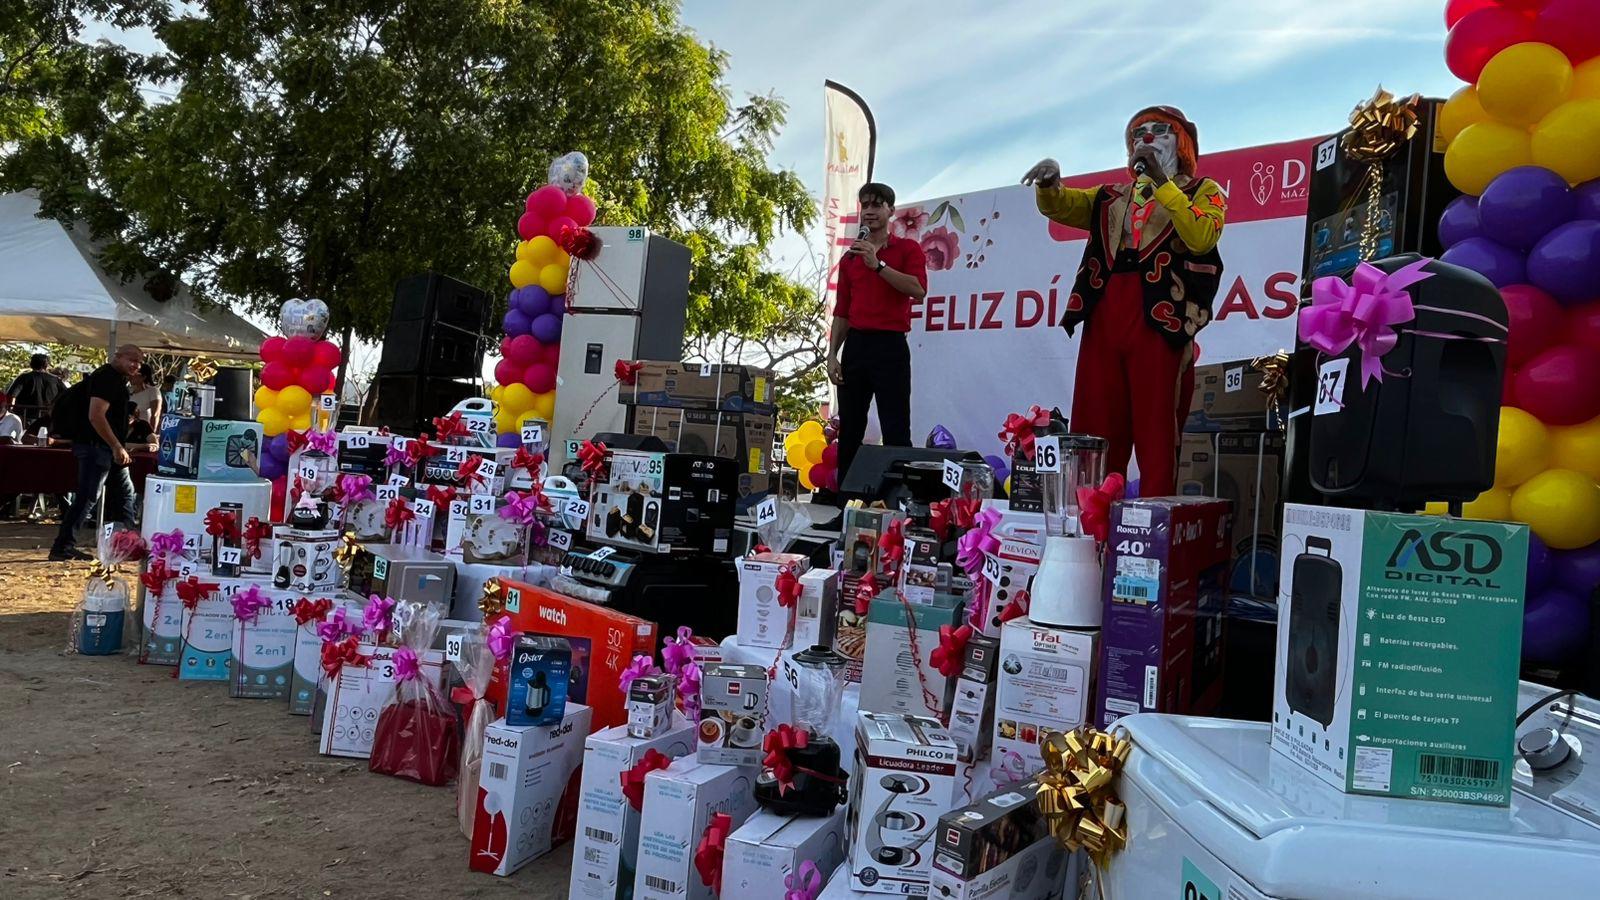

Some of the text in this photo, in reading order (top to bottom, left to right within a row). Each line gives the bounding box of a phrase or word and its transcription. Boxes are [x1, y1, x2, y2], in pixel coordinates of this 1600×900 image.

[1320, 143, 1334, 164] 37
[1280, 187, 1309, 199] MAZ
[628, 229, 642, 239] 98
[909, 291, 1005, 332] FELIZ
[1014, 274, 1062, 329] DÍ
[703, 364, 709, 373] 1
[1226, 372, 1240, 388] 36
[1317, 369, 1341, 404] 67
[324, 397, 333, 407] 9
[205, 421, 230, 433] Oster
[468, 420, 486, 432] 22
[523, 429, 539, 440] 27
[350, 436, 367, 447] 10
[449, 451, 463, 461] 21
[1036, 444, 1057, 468] 66
[302, 467, 315, 479] 19
[482, 462, 494, 475] 26
[648, 460, 662, 475] 95
[945, 468, 960, 487] 53
[378, 489, 396, 500] 20
[415, 503, 430, 515] 24
[473, 499, 491, 511] 31
[568, 502, 586, 515] 28
[759, 504, 775, 520] 44
[1140, 528, 1152, 536] TV
[185, 538, 195, 548] 4
[550, 532, 568, 546] 29
[1004, 544, 1038, 556] REVLON
[1385, 528, 1503, 575] ASD
[222, 551, 238, 563] 17
[182, 566, 191, 576] 5
[375, 559, 386, 574] 96
[986, 557, 999, 580] 63
[276, 598, 295, 611] 18
[507, 590, 519, 608] 91
[539, 604, 568, 627] watch
[1381, 612, 1395, 620] Luz
[1396, 613, 1407, 621] de
[1431, 616, 1446, 624] LED
[448, 641, 460, 657] 39
[518, 651, 544, 665] Oster
[605, 650, 619, 671] 4K
[1378, 661, 1389, 669] FM
[783, 660, 798, 690] 56
[1376, 686, 1493, 703] Interfaz de bus serie universal
[1383, 712, 1409, 723] puerto
[1423, 716, 1449, 726] tarjeta
[1372, 736, 1467, 750] Importaciones auxiliares
[906, 748, 943, 760] PHILCO
[878, 758, 945, 772] Licuadora Leader
[1410, 785, 1429, 796] S/N:
